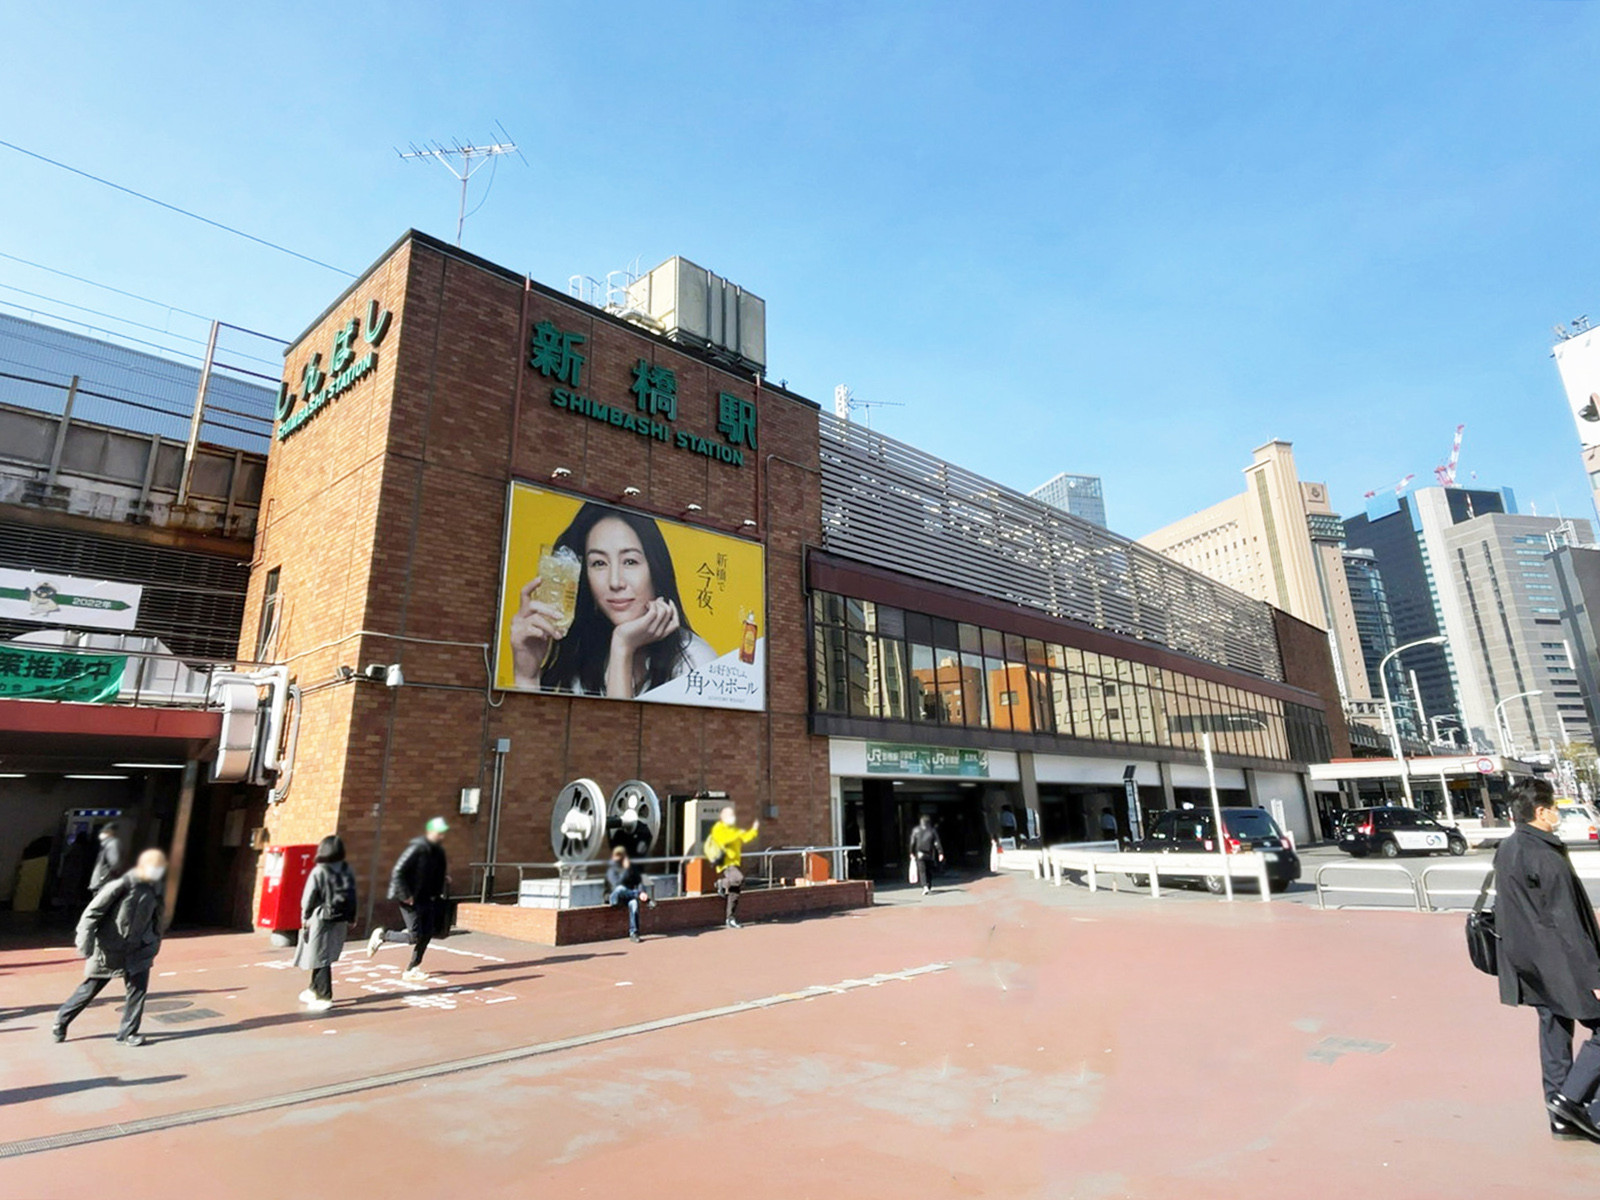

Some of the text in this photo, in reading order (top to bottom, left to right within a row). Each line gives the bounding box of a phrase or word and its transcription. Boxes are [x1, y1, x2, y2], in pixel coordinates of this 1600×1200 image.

[327, 351, 378, 401] STATION
[530, 320, 758, 450] 新橋駅
[552, 387, 745, 468] SHIMBASHI STATION
[72, 597, 112, 609] 2022年
[695, 562, 715, 616] 今夜、
[685, 668, 759, 696] 角ハイボール
[867, 748, 882, 762] JR
[932, 752, 945, 765] JR
